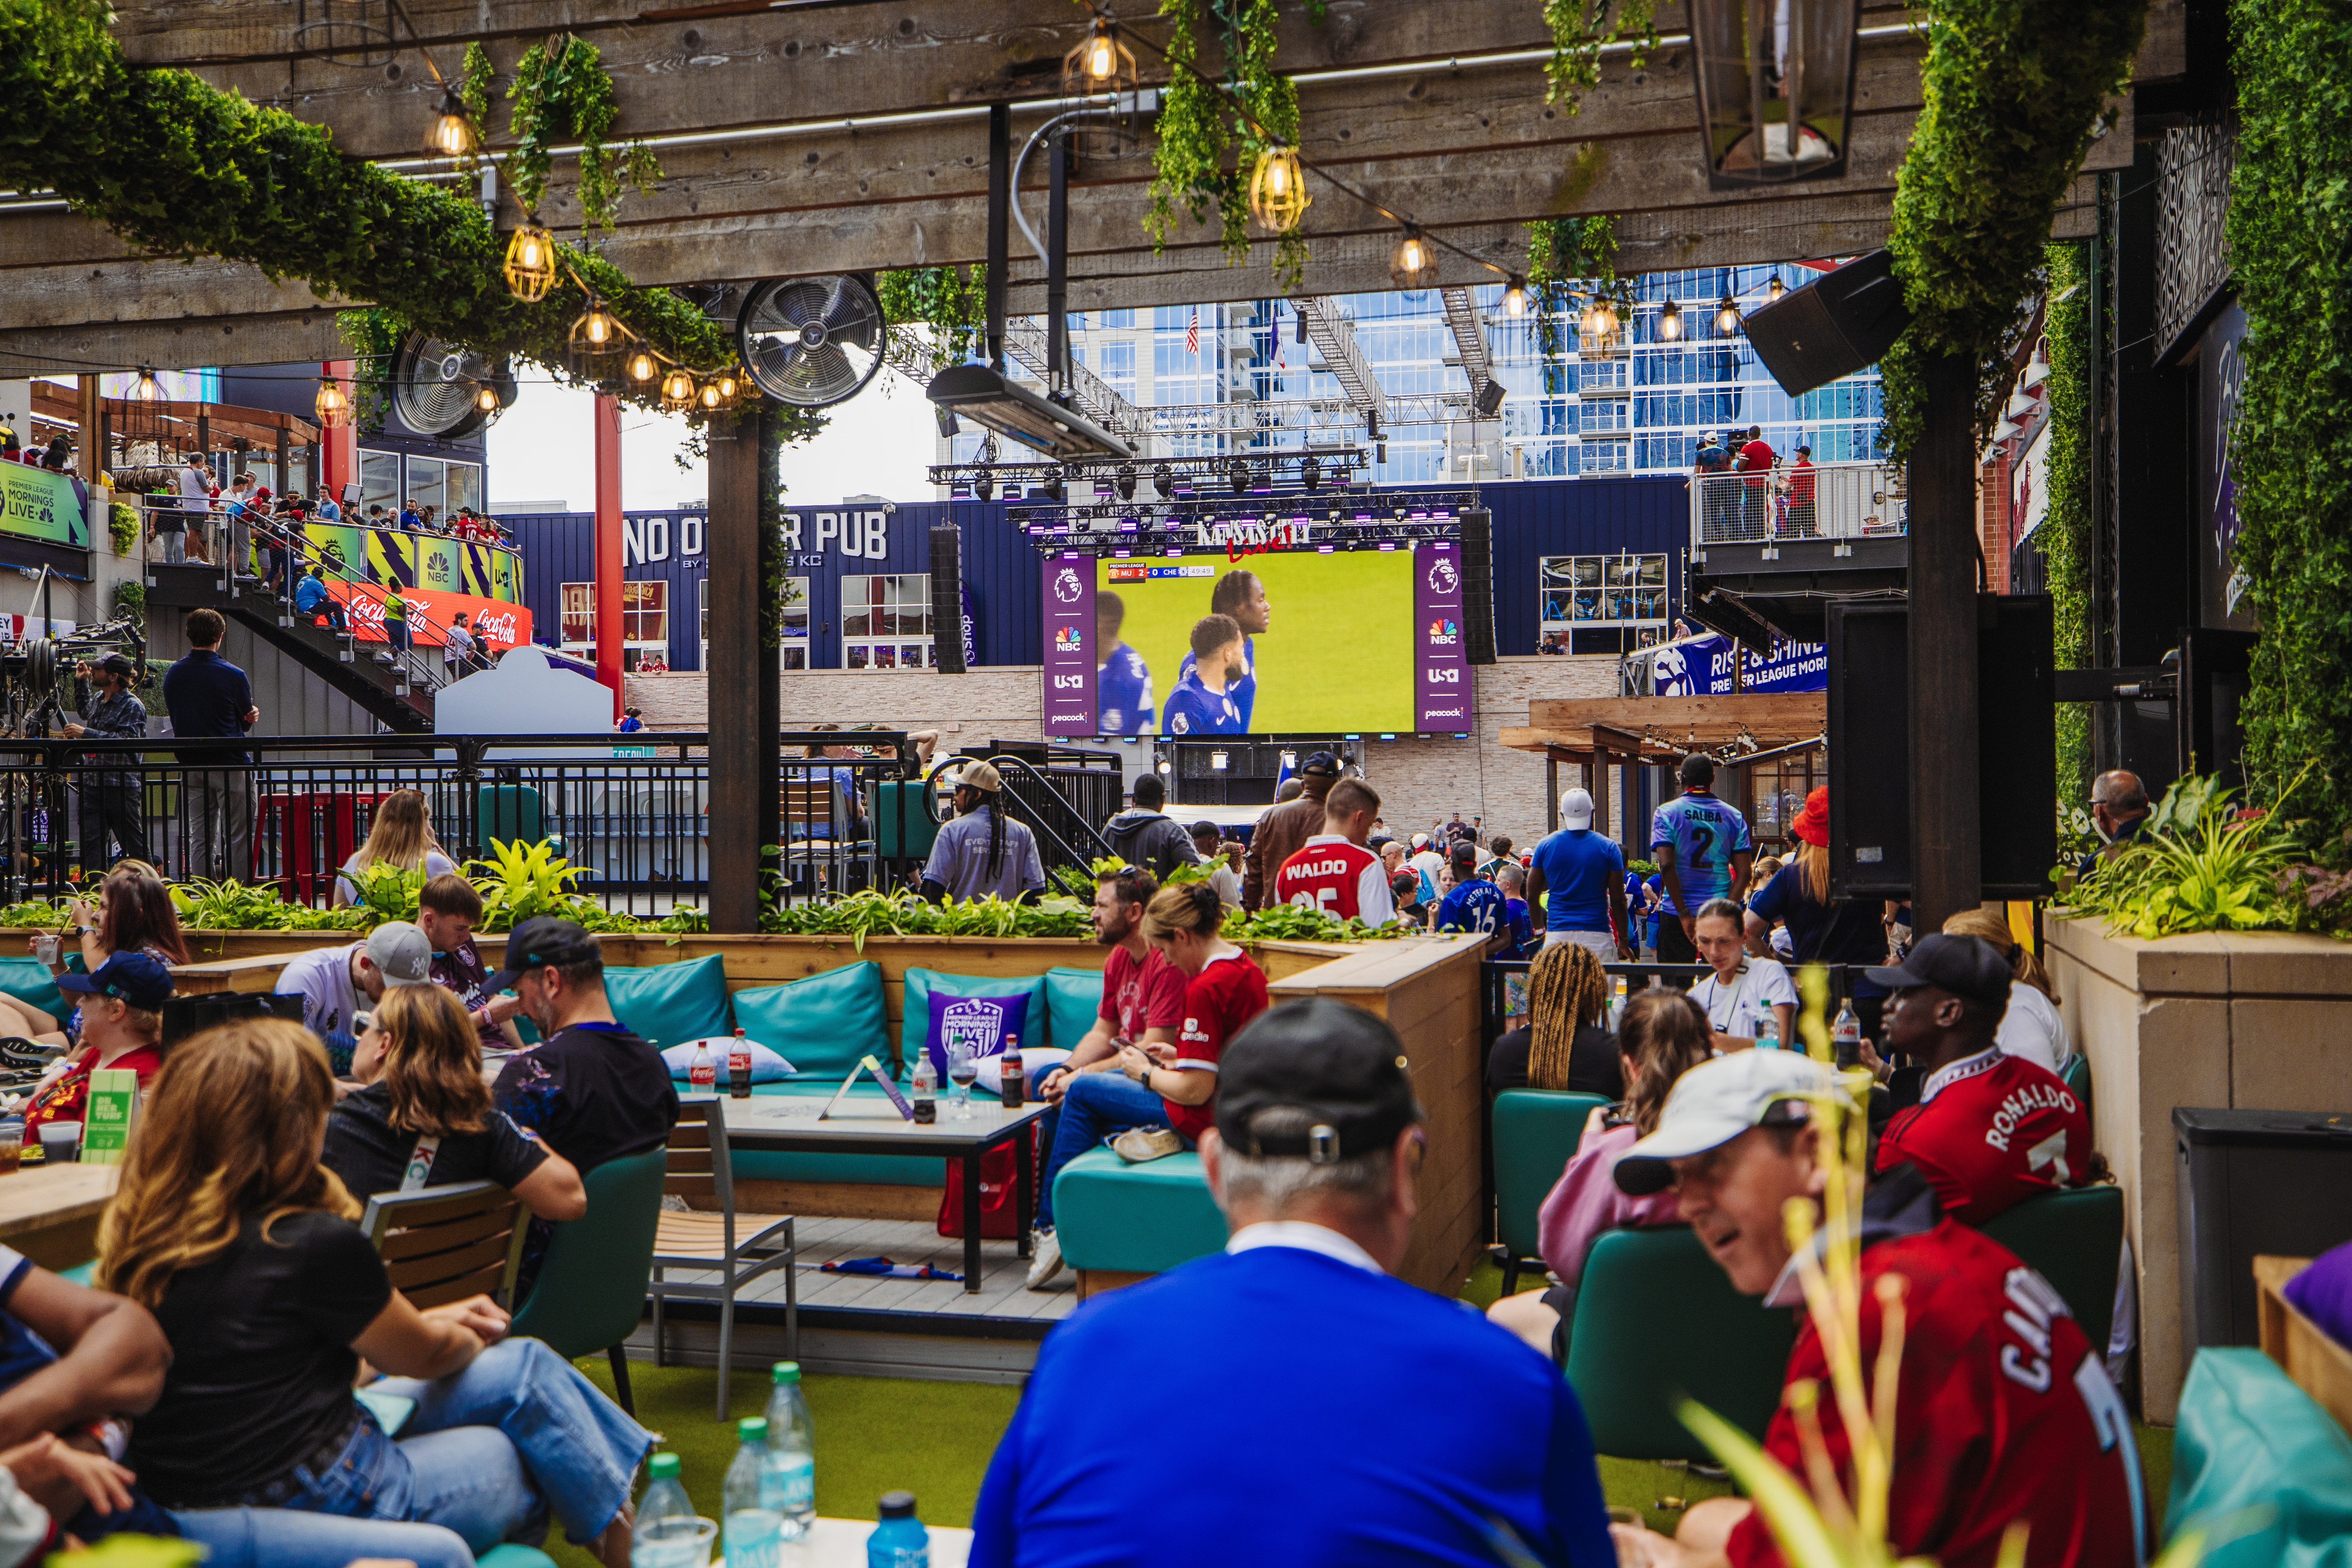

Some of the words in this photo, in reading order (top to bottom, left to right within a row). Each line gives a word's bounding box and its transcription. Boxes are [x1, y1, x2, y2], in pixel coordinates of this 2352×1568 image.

[9, 480, 32, 490] PREMIER
[33, 486, 54, 495] LEAGUE
[9, 489, 54, 507] MORNINGS
[9, 501, 34, 519] LIVE
[466, 529, 477, 541] 10
[623, 518, 668, 567] NO
[816, 512, 886, 560] PUB
[1227, 524, 1293, 563] Live!
[800, 555, 822, 566] KC
[428, 572, 448, 583] NBC
[1057, 642, 1081, 652] NBC
[1431, 635, 1457, 644] NBC
[1054, 675, 1083, 688] usa
[1428, 669, 1459, 682] usa
[1711, 675, 1754, 693] PREER
[1756, 664, 1797, 684] LEAGUE
[1052, 713, 1085, 724] peacock
[1425, 708, 1461, 720] peacock
[1684, 809, 1723, 823] SALIBA
[1691, 828, 1714, 868] 2
[1287, 860, 1347, 880] WALDO
[1472, 903, 1496, 933] 16
[946, 1020, 997, 1029] MORNINGS
[1985, 1083, 2076, 1152] RONALDO
[408, 1146, 436, 1181] KC
